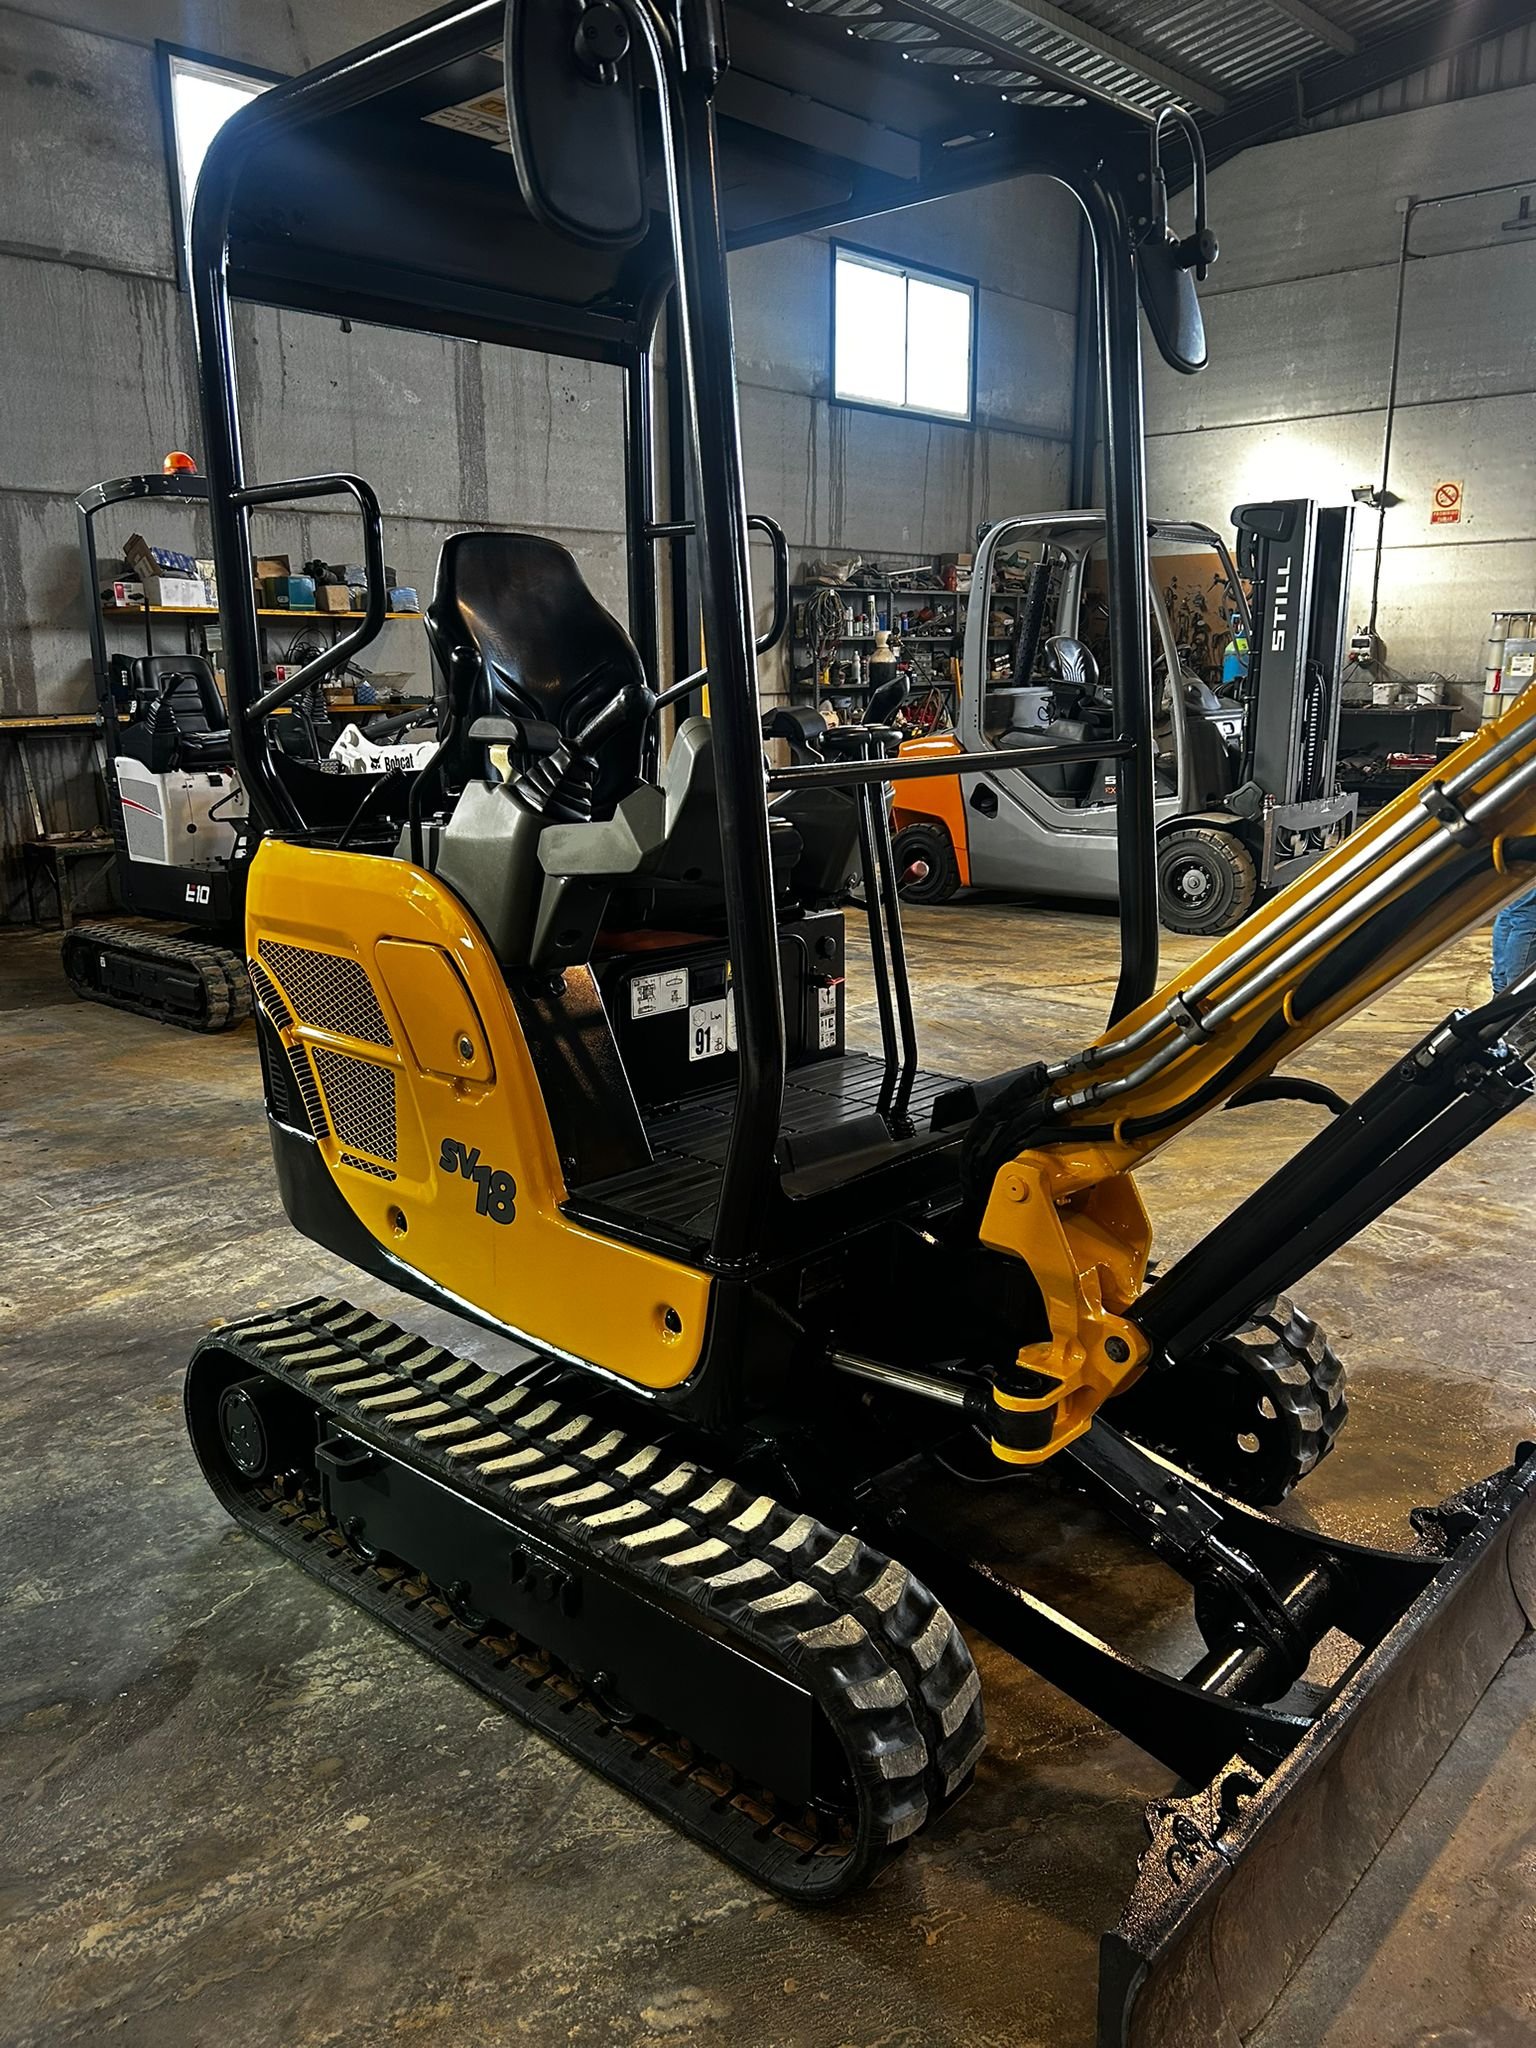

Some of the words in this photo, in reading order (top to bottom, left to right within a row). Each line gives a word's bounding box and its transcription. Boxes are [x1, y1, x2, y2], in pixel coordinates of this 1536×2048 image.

[1271, 557, 1291, 651] STILL
[384, 753, 414, 771] Bobcat
[185, 883, 210, 904] E10
[695, 1026, 711, 1055] 91
